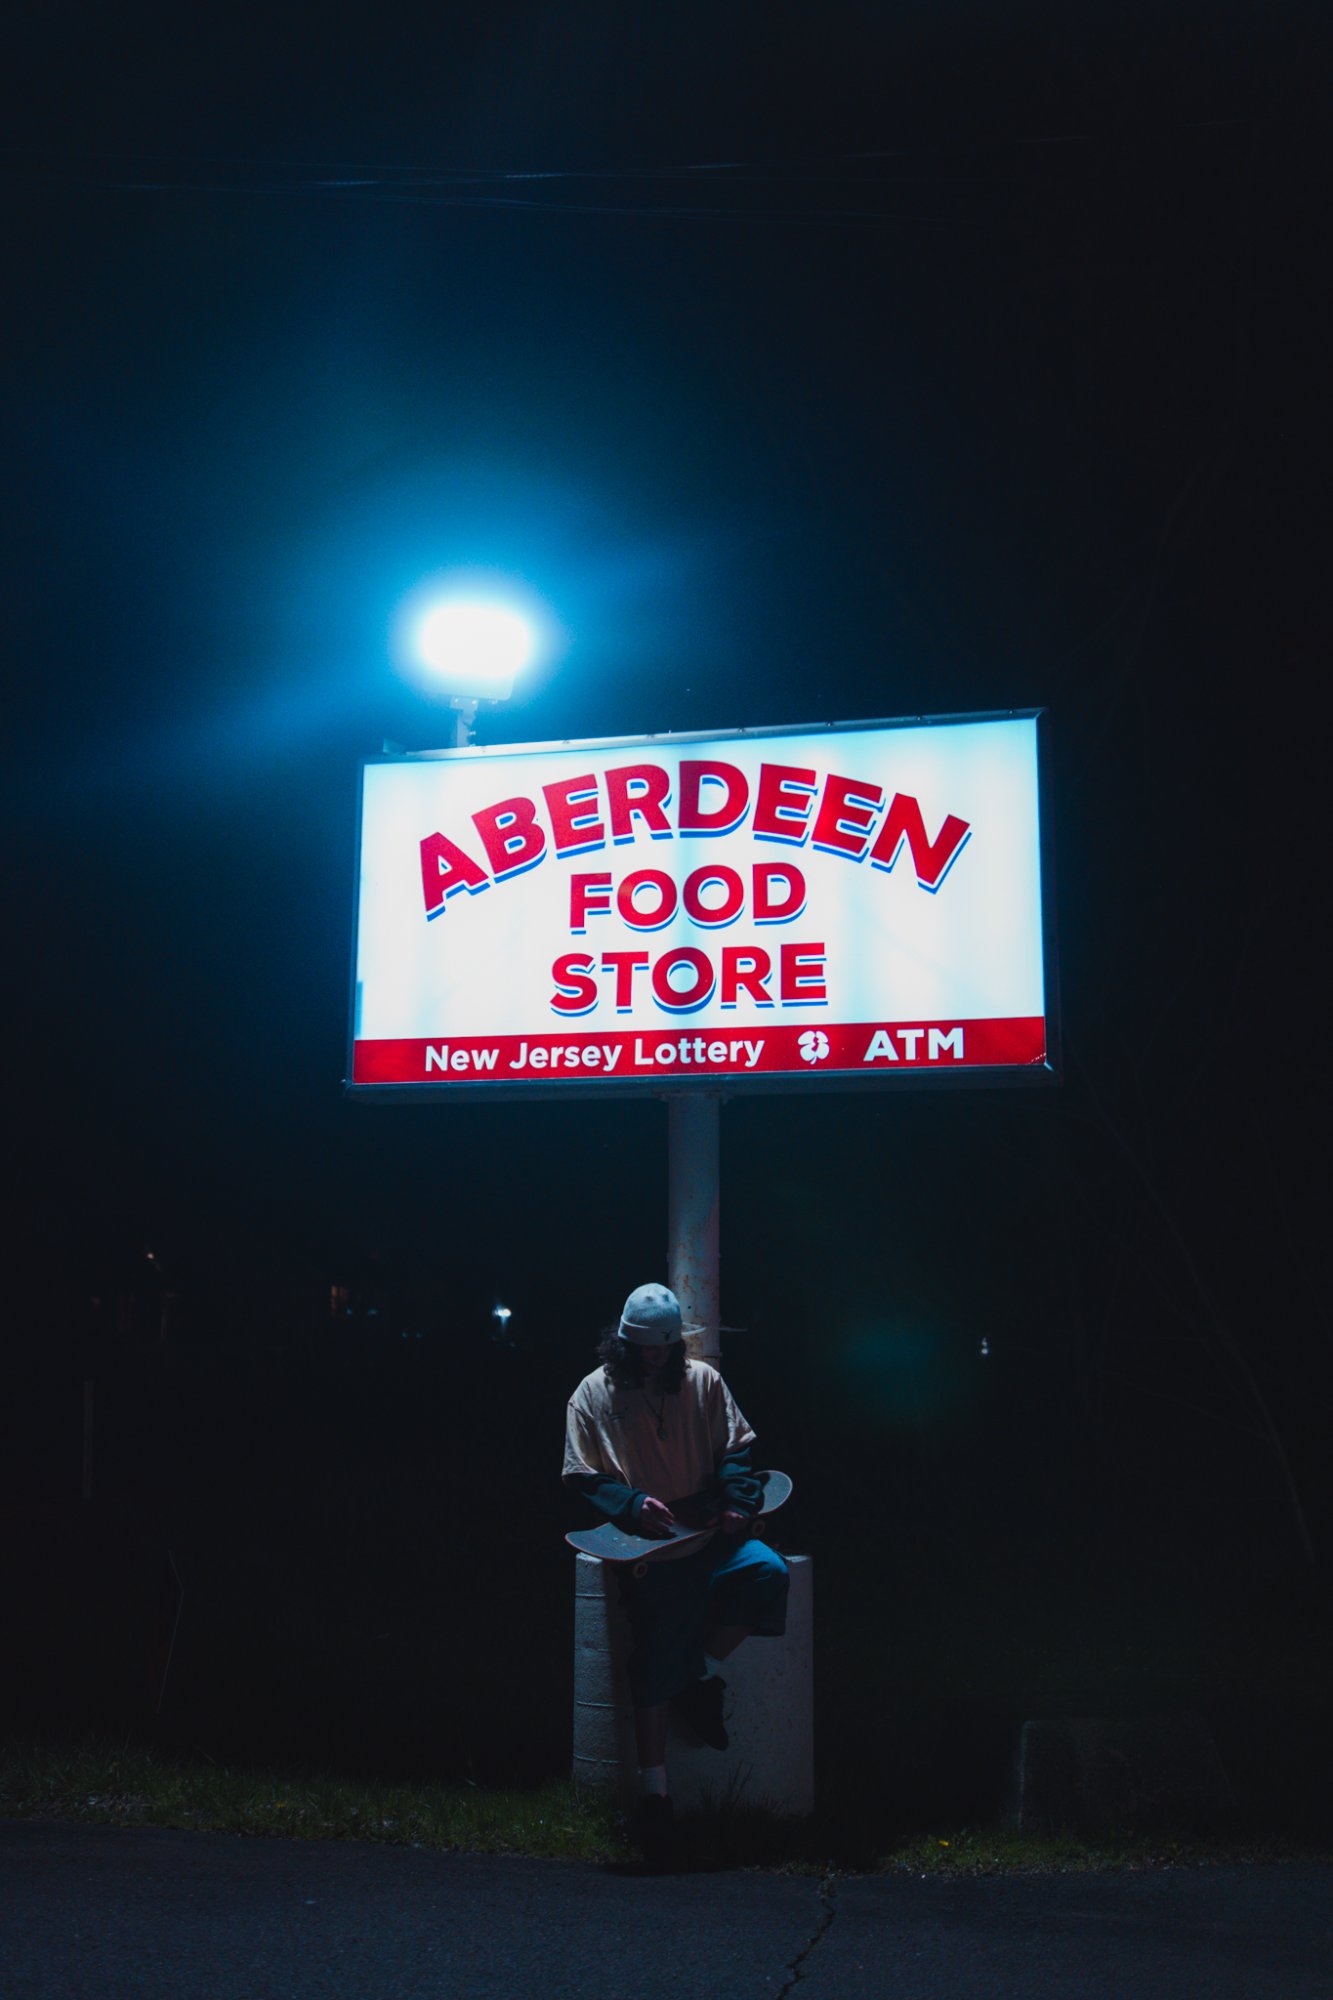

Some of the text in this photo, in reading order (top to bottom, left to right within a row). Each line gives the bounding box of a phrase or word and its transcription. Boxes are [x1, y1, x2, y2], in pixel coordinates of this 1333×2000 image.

[419, 760, 971, 921] ABERDEEN
[569, 862, 806, 935] FOOD
[550, 942, 828, 1016] STORE
[425, 1038, 765, 1072] New Jersey Lottery
[863, 1027, 965, 1062] ATM
